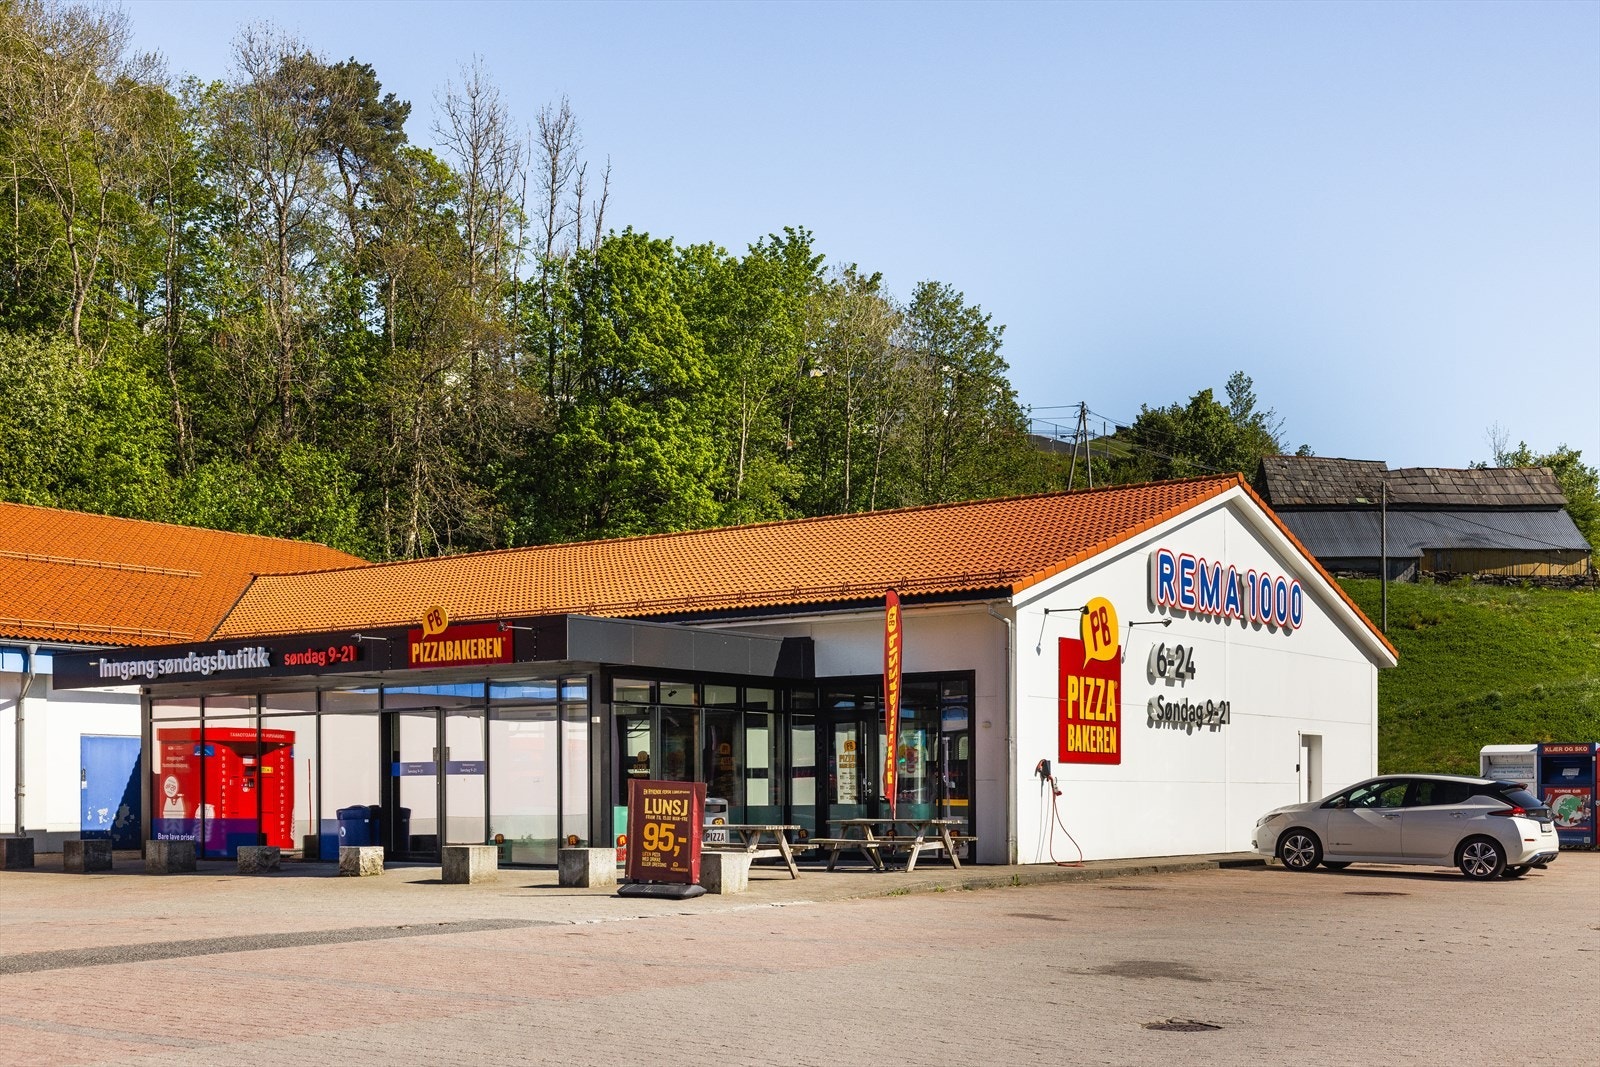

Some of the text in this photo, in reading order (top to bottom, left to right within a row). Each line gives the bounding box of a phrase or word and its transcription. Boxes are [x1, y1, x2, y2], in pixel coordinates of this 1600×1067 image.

[1156, 548, 1304, 630] REMA 1000
[427, 608, 443, 632] PB
[1089, 606, 1112, 652] PB
[99, 647, 270, 680] Inngang søndagsbutikk
[284, 645, 356, 667] søndag 9-21
[411, 637, 503, 663] PIZZABAKEREN
[1156, 642, 1196, 680] 6-24
[1067, 675, 1117, 722] PIZZA
[1156, 694, 1231, 728] Søndag 9-21
[1067, 724, 1117, 754] BAKEREN
[644, 797, 689, 817] LUNSJ
[157, 832, 169, 840] Bare
[180, 833, 196, 841] priser
[643, 822, 688, 857] 95,-
[705, 832, 725, 842] PIZZA
